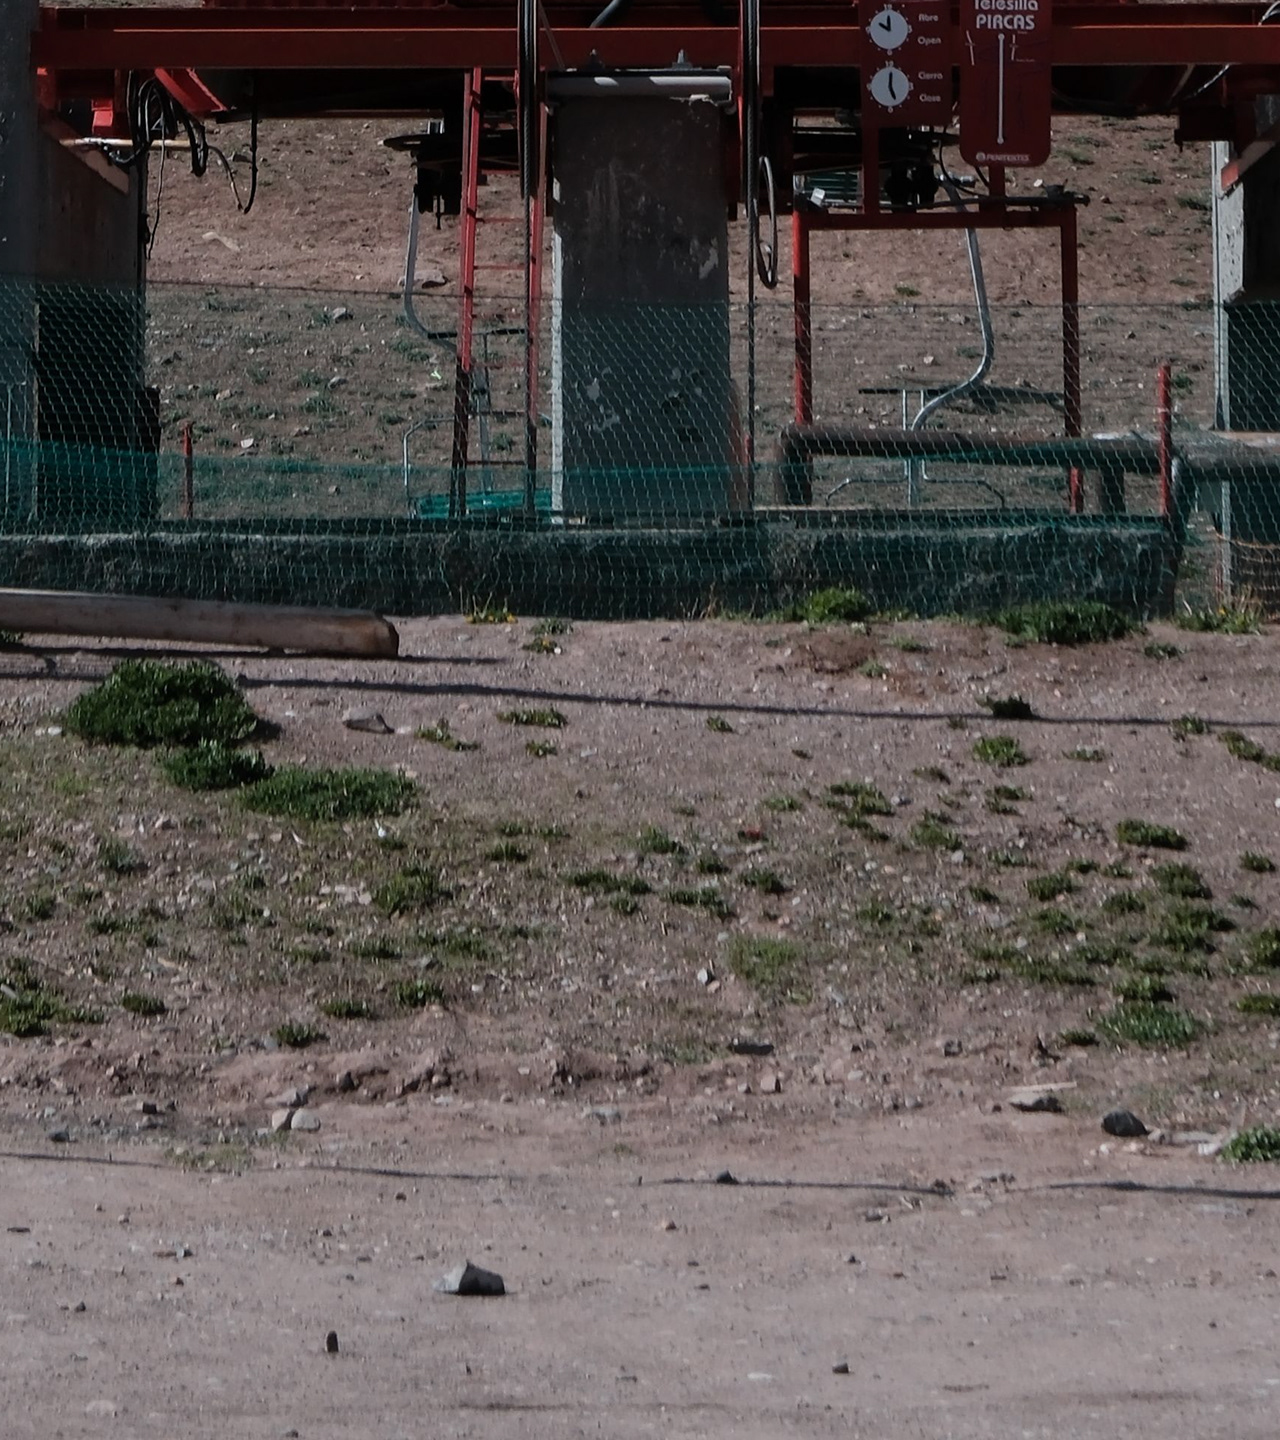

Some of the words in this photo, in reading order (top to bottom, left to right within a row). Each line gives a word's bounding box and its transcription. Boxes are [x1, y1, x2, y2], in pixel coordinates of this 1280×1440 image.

[918, 13, 939, 22] Abre
[976, 14, 1035, 30] PIRCAS
[917, 36, 942, 46] Open
